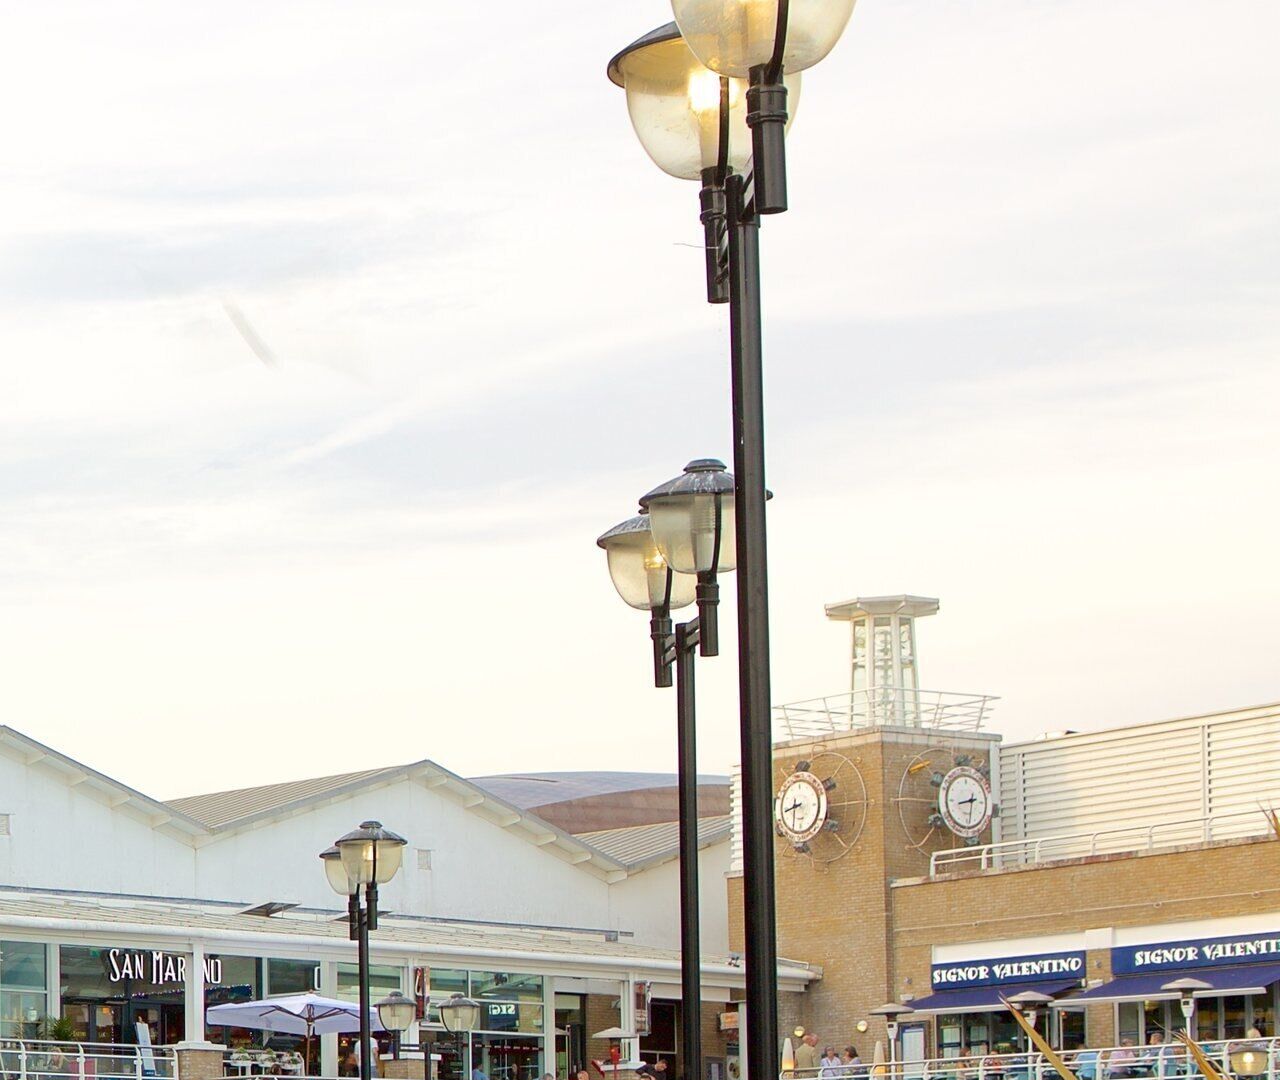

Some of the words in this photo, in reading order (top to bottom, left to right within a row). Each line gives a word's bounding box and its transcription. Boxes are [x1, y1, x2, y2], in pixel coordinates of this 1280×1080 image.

[108, 948, 144, 983] SAN
[151, 951, 222, 985] MARNO
[932, 966, 989, 985] SIGNOR
[992, 957, 1082, 980] VALENTINO
[1134, 947, 1199, 968] SIGNOR
